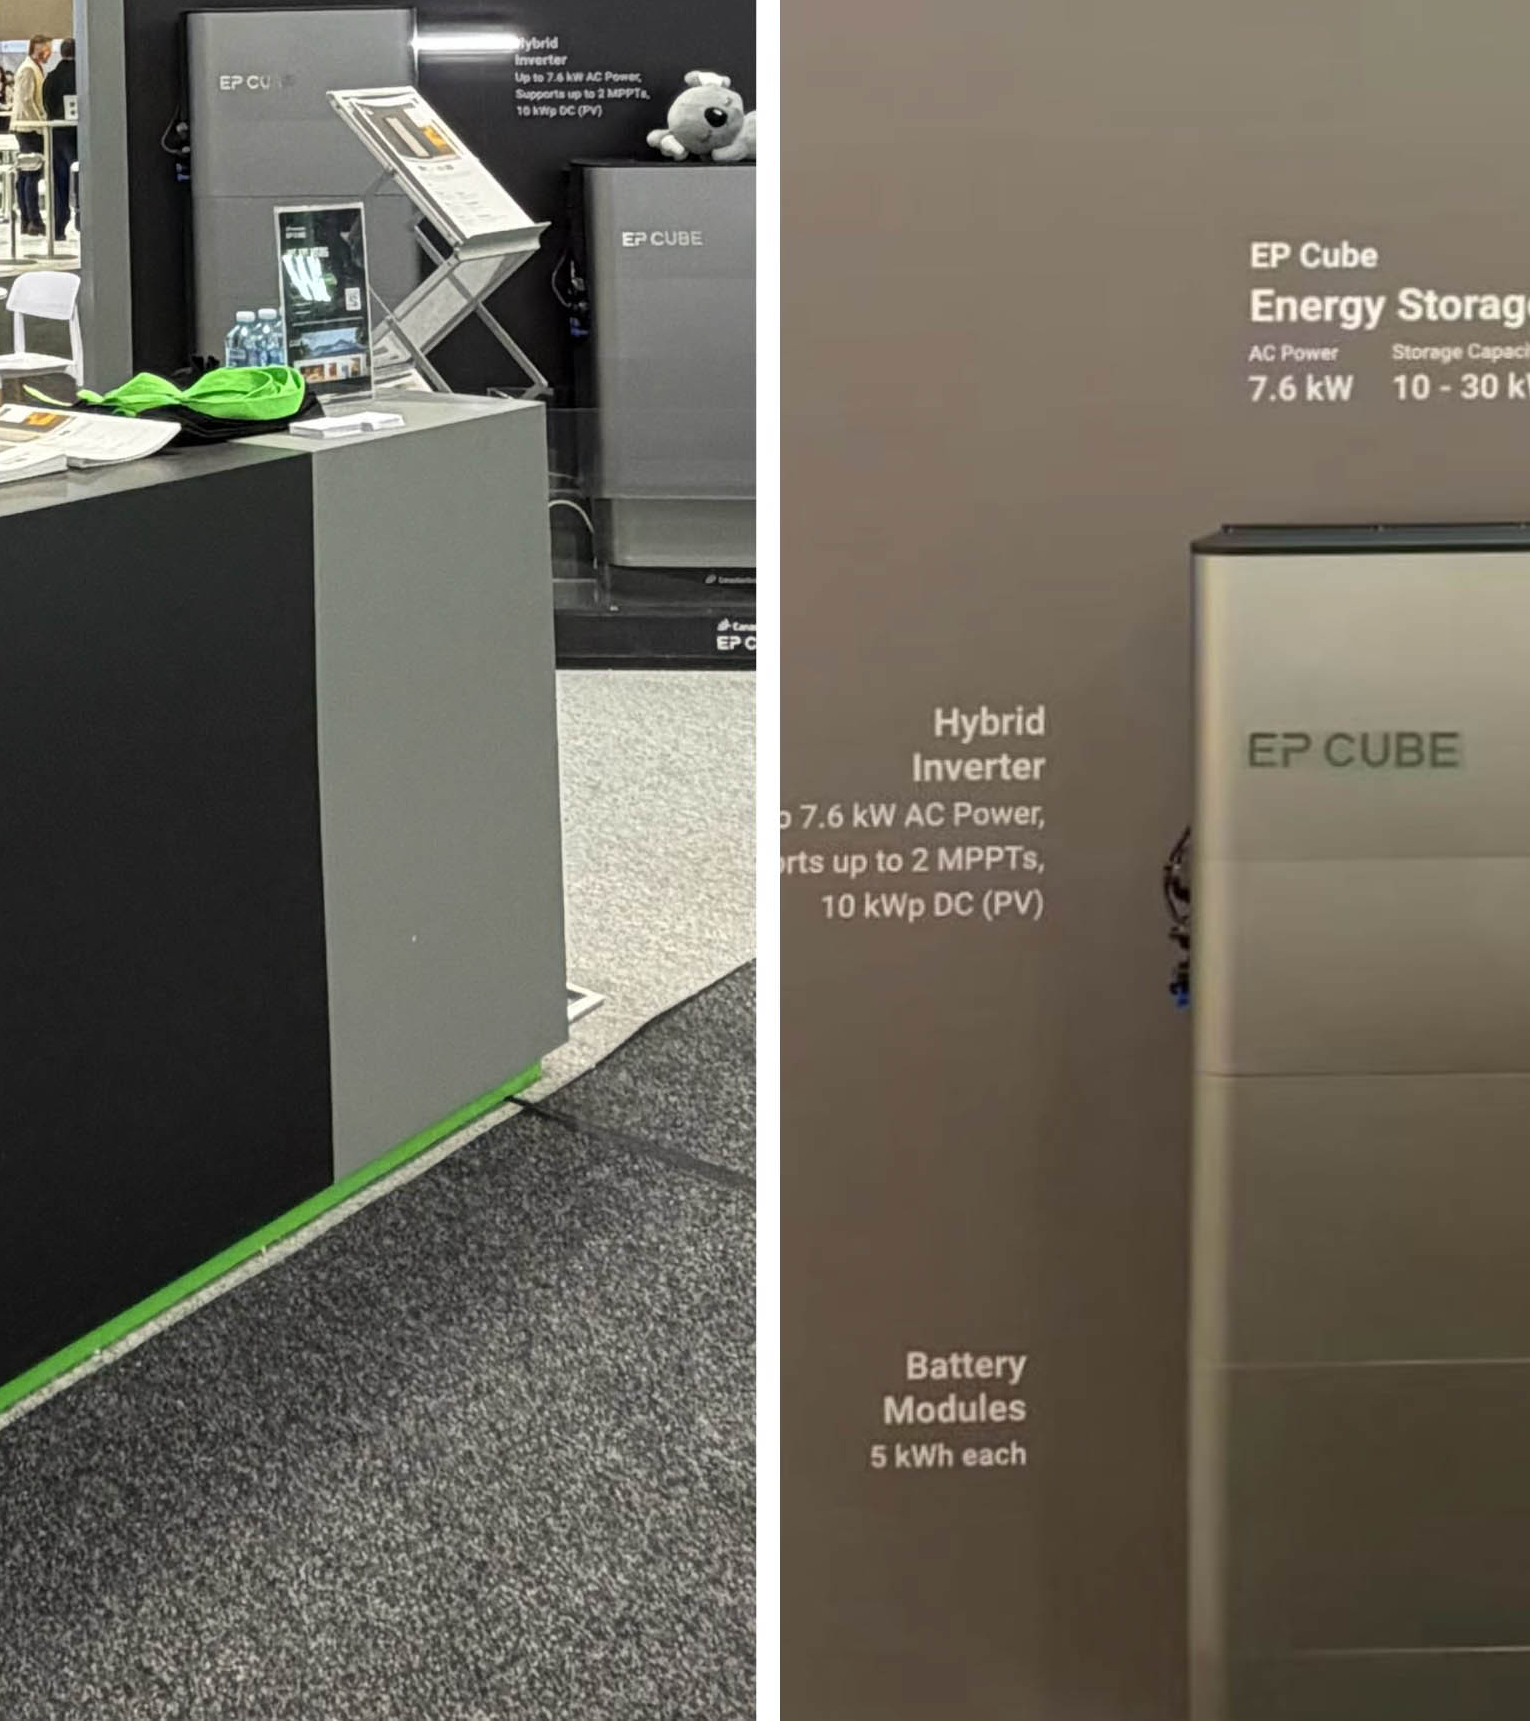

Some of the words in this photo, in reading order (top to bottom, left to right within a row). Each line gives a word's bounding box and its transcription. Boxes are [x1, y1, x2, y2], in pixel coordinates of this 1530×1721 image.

[622, 232, 647, 246] EP
[650, 231, 702, 246] CUBE
[1251, 241, 1292, 269] EP
[1299, 240, 1379, 269] Cube
[1251, 288, 1387, 331] Energy
[934, 705, 1045, 745] Hybrid
[1248, 732, 1311, 768] EP
[1324, 732, 1460, 768] CUBE
[913, 752, 1046, 782] Inverter
[906, 1351, 1027, 1385] Battery
[883, 1392, 1026, 1425] Modules
[870, 1444, 887, 1469] 5
[895, 1442, 954, 1468] kWh
[962, 1440, 1027, 1467] each
